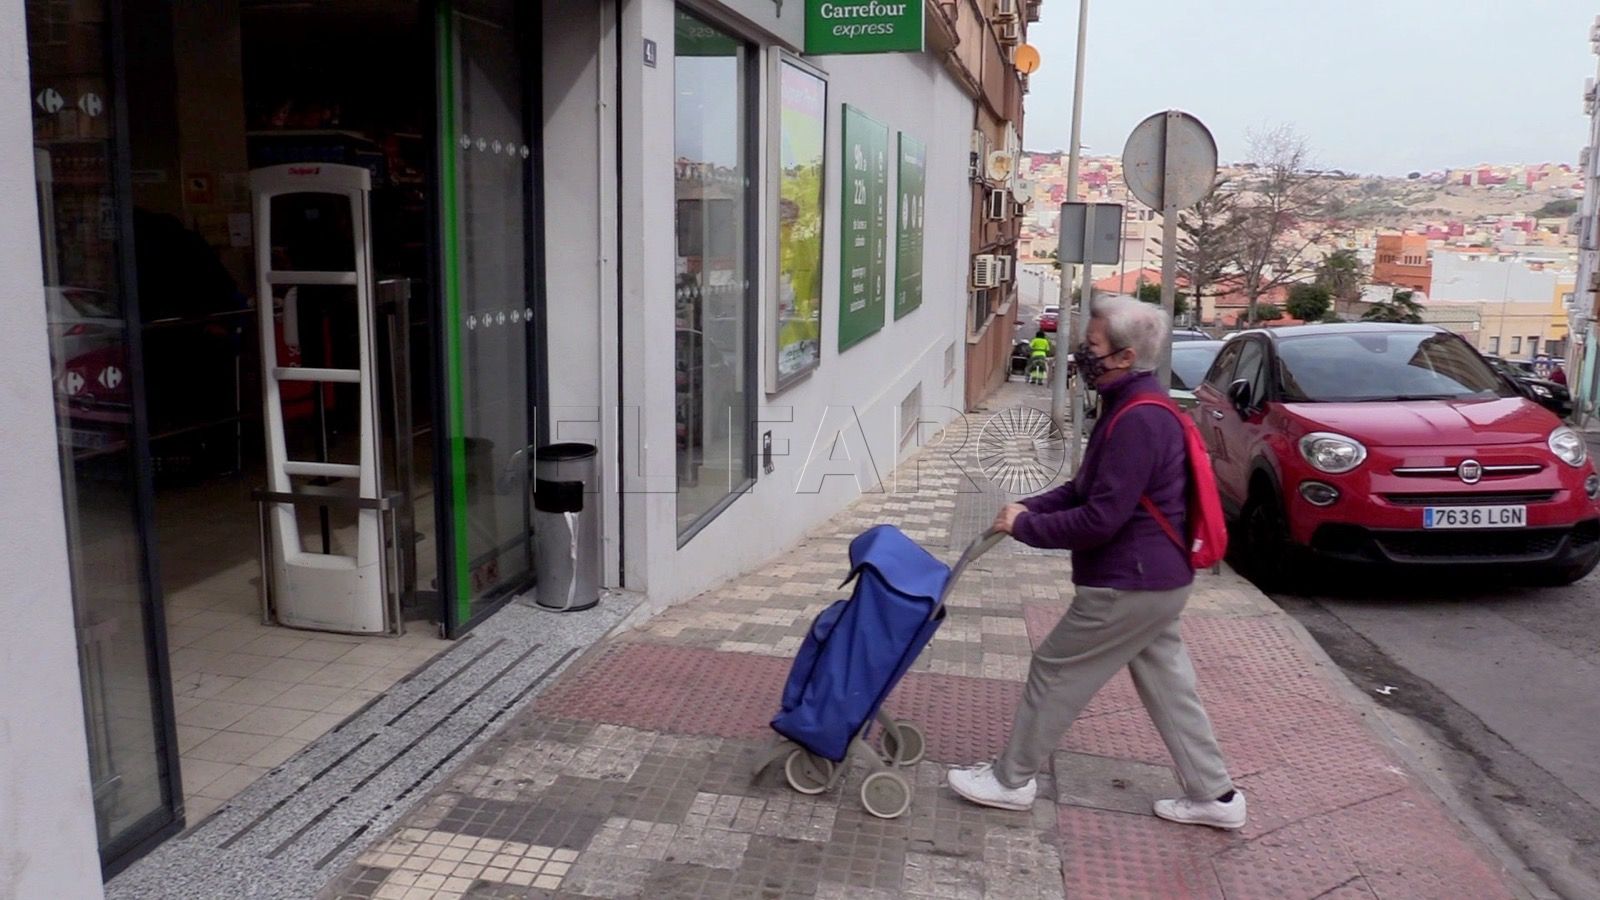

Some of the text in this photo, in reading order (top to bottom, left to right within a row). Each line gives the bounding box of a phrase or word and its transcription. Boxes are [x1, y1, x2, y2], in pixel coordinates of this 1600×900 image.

[820, 0, 907, 19] Carrefour
[832, 22, 894, 39] express
[854, 178, 867, 205] 22h
[1435, 508, 1522, 525] 7636 LGN
